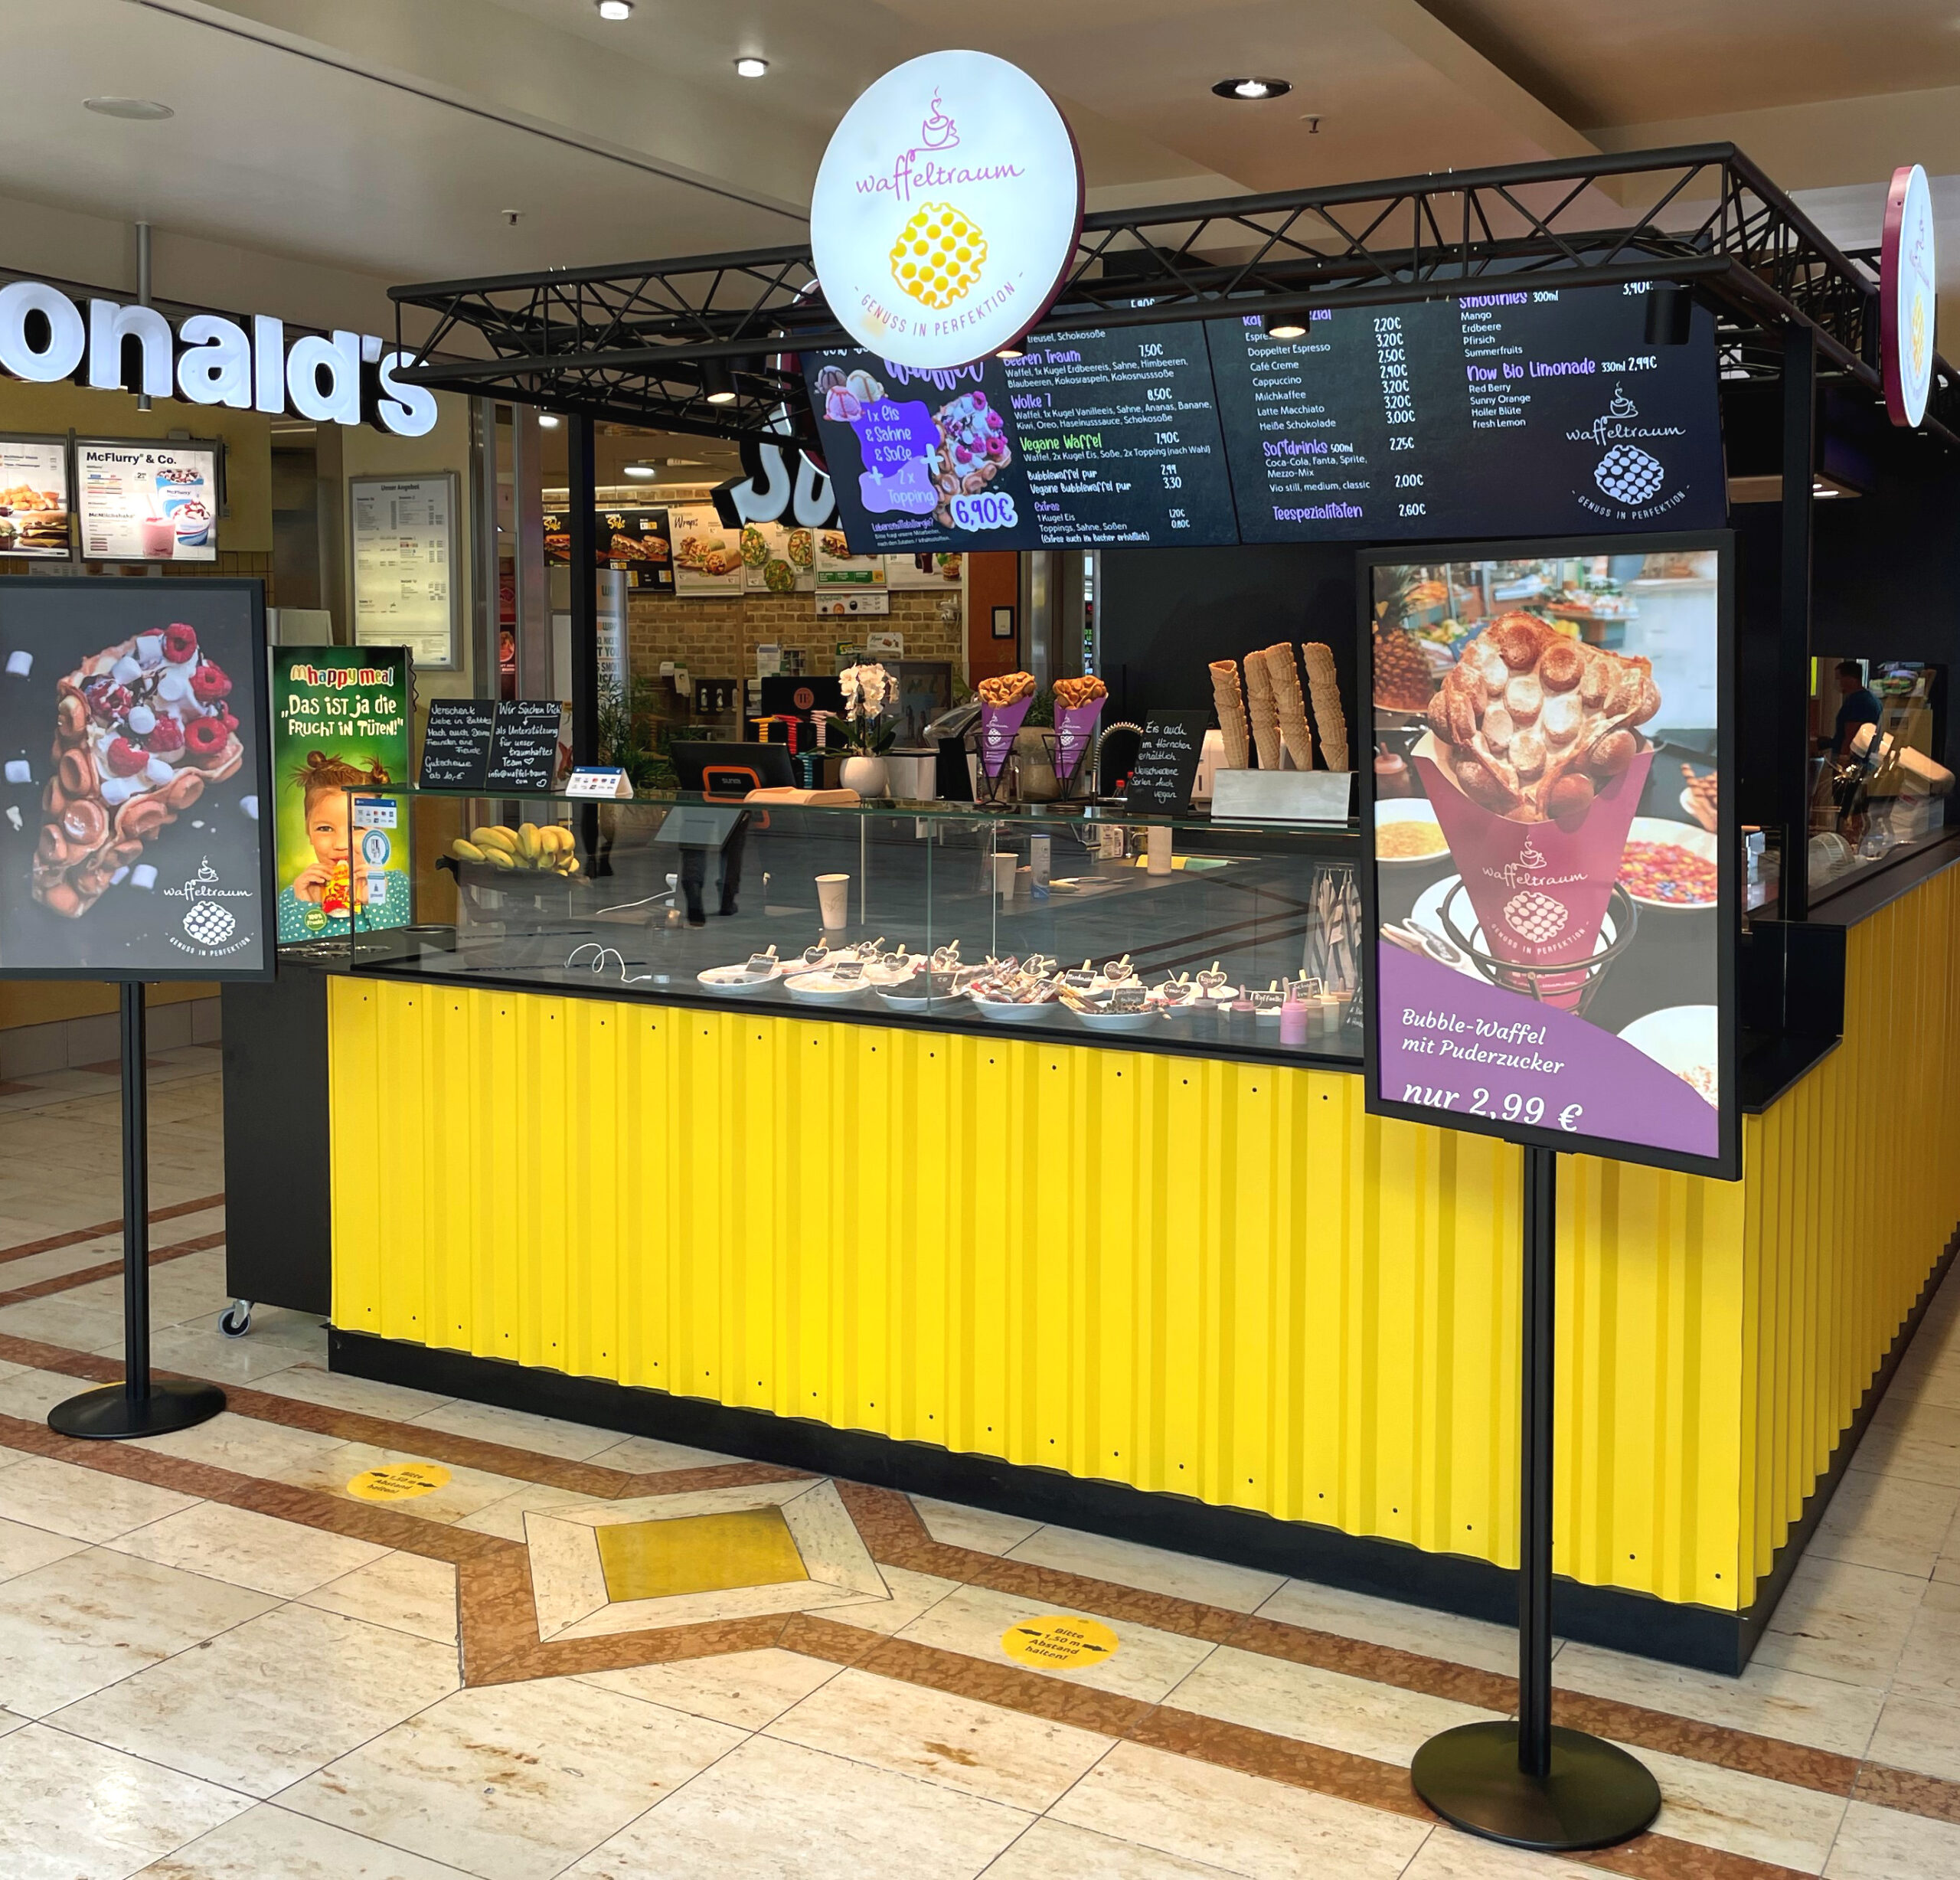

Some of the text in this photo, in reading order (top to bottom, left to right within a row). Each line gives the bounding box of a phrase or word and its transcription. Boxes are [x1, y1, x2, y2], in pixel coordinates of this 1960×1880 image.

[856, 149, 1025, 202] waffeltraum
[1533, 290, 1559, 303] 300ml
[861, 281, 1015, 337] GENUSS IN PERFEKTION
[1461, 312, 1491, 322] Mango
[1374, 316, 1402, 332] 2,20€
[1462, 322, 1501, 333] Erdbeere
[1057, 329, 1106, 342] Schokosoße
[1376, 332, 1403, 347] 3,20€
[1463, 335, 1495, 345] Pfirsich
[1044, 349, 1081, 364] Traum
[1138, 344, 1164, 358] 7,50€
[1247, 344, 1406, 363] Doppelter Espresso 2,50€
[1465, 345, 1523, 358] Summerfruits
[1005, 358, 1188, 378] Waffel, Kugel Erdbeereis, Sahne, Himbeeren,
[1250, 361, 1408, 378] Café Creme 2,90€
[1502, 362, 1524, 379] Bio
[1529, 357, 1596, 378] Limonade
[1601, 359, 1626, 373] 330ml
[1628, 355, 1658, 372] 2,99€
[1008, 369, 1174, 388] Blaubeeren, Kokosraspeln, Kokosnusssoße
[1253, 376, 1410, 394] Cappuccino 3,20€
[1468, 383, 1511, 394] Red Berry
[1011, 394, 1042, 409] Wolke
[1255, 390, 1412, 410] Milchkaffee 3,20€
[1470, 394, 1531, 406] Sunny Orange
[1014, 401, 1212, 420] Waffel, Kugel Vanilleeis, Sahne, Ananas, Banane,
[1123, 414, 1173, 424] Schokosoße
[1257, 405, 1416, 424] Latte Macchiato 3,00€
[1471, 406, 1521, 417] Holler Blüte
[1259, 419, 1337, 431] Heiße Schokolade
[1472, 418, 1526, 429] Fresh Lemon
[1566, 416, 1687, 446] waffeltraum
[875, 425, 912, 442] Sahne
[1019, 432, 1180, 453] Vegane Waffel 7,90€
[1263, 438, 1328, 458] Softdrinks
[1330, 443, 1354, 453] 500ml
[145, 454, 155, 463] &
[158, 455, 177, 465] Co.
[884, 445, 913, 462] Soße
[1023, 445, 1210, 462] Waffel, Kugel Topping (nach Wahl)
[1266, 455, 1367, 467] Coca-Cola, Fanta, Sprite,
[1027, 468, 1098, 481] Bubblewaffel pur
[1268, 468, 1315, 478] Mezzo-Mix
[1030, 483, 1058, 495] Vegane
[1116, 482, 1132, 493] pur
[1162, 476, 1182, 489] 3,30
[1269, 474, 1424, 492] Vio still, medium, classic 2,00€
[887, 488, 936, 507] Topping
[1578, 491, 1686, 520] GENUSS IN PERFEKTION
[956, 498, 1013, 527] 6,90€
[1041, 514, 1063, 524] Kugel
[1272, 502, 1426, 523] Teespezialitäten 2,60€
[1039, 522, 1127, 534] Toppings, Sahne, Soßen
[360, 667, 394, 685] meal
[374, 694, 397, 715] die
[498, 701, 517, 714] Wir
[1482, 862, 1589, 889] waffeltraum
[163, 879, 253, 901] waffeltraum
[1522, 945, 1531, 954] IN
[1537, 928, 1586, 955] PERFEKTION
[1402, 1009, 1547, 1045] Bubble-Waffel
[1402, 1036, 1565, 1074] mit Puderzucker
[1403, 1084, 1583, 1132] nur 2,99 €
[1054, 1628, 1085, 1640] Bitte
[1024, 1646, 1069, 1660] halten!
[1028, 1639, 1080, 1655] Abstand
